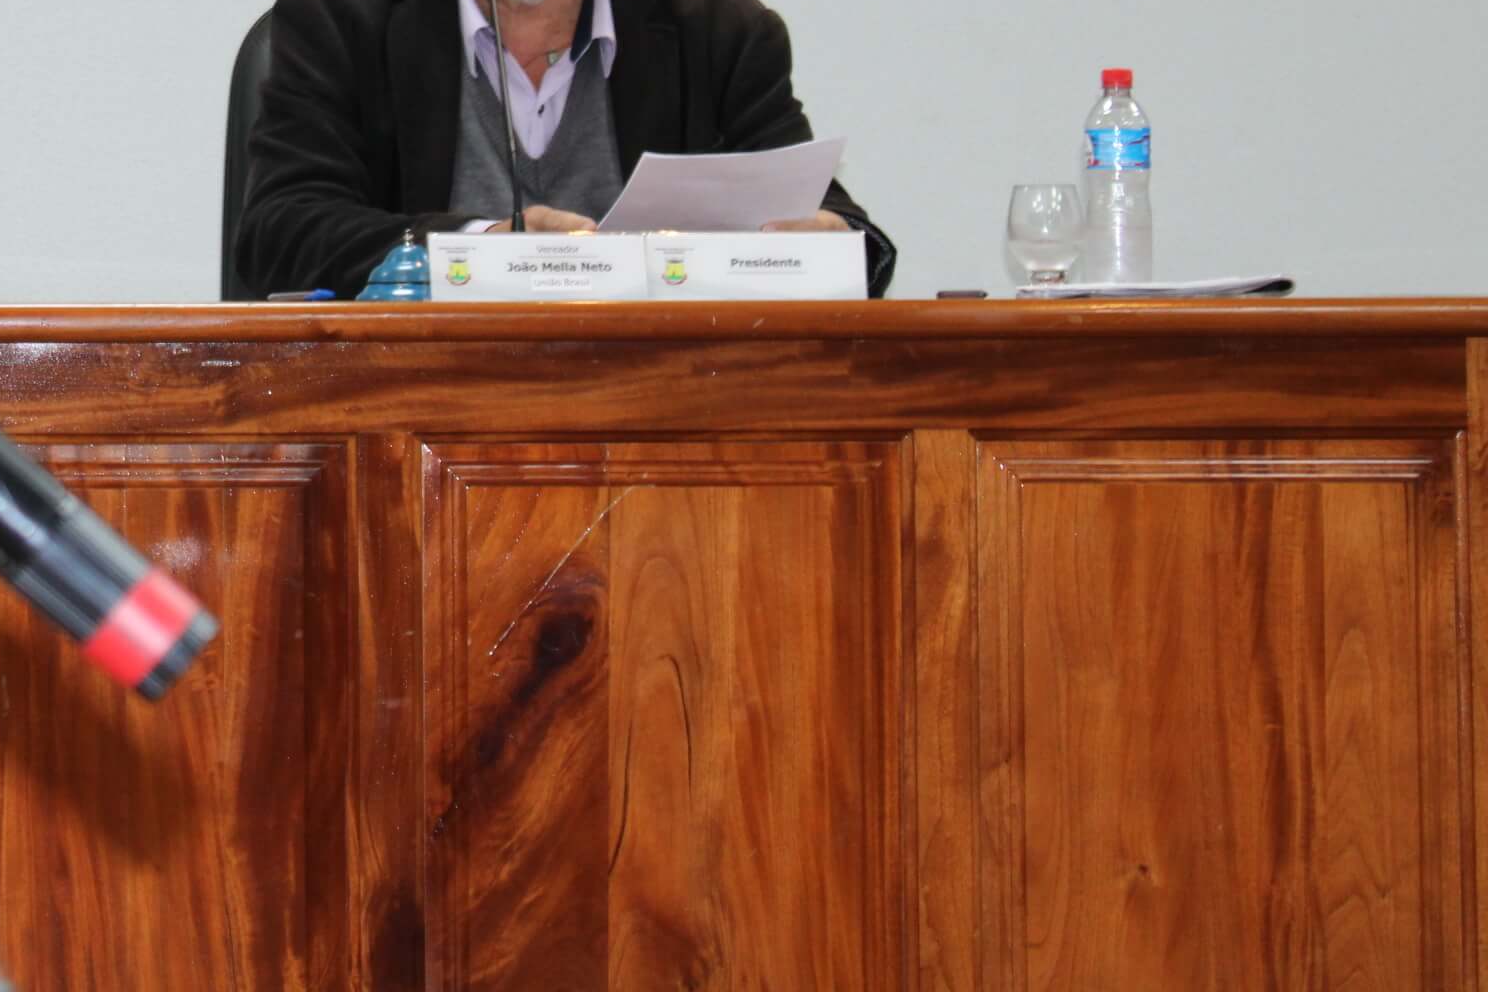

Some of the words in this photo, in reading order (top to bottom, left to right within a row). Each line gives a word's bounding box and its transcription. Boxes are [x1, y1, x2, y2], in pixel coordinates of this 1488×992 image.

[507, 261, 538, 273] João
[581, 261, 613, 273] Neto
[730, 258, 802, 268] Presidente
